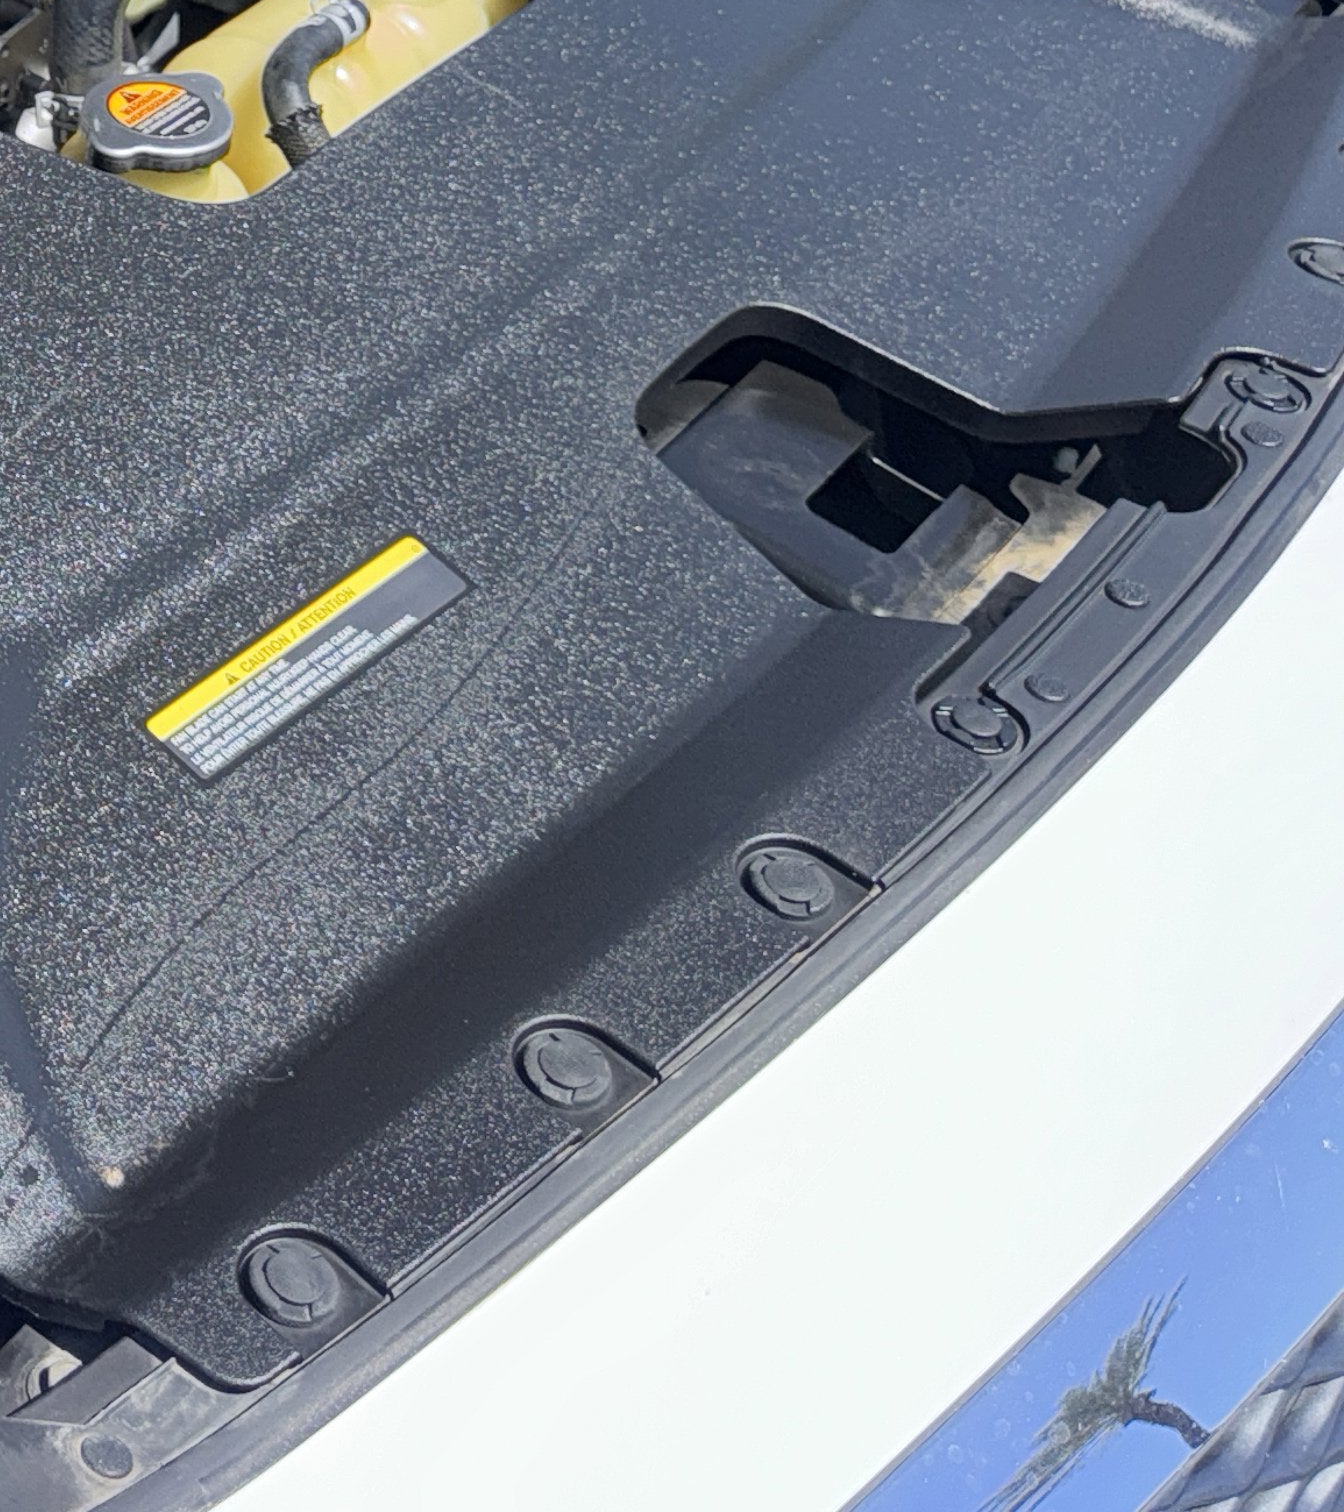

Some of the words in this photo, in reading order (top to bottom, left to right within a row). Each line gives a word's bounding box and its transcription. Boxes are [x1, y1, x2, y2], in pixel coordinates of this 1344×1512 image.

[239, 634, 292, 673] CAUTION
[298, 586, 357, 634] ATTENTION
[206, 702, 228, 719] CAN
[178, 741, 195, 755] TO
[189, 752, 205, 765] LE
